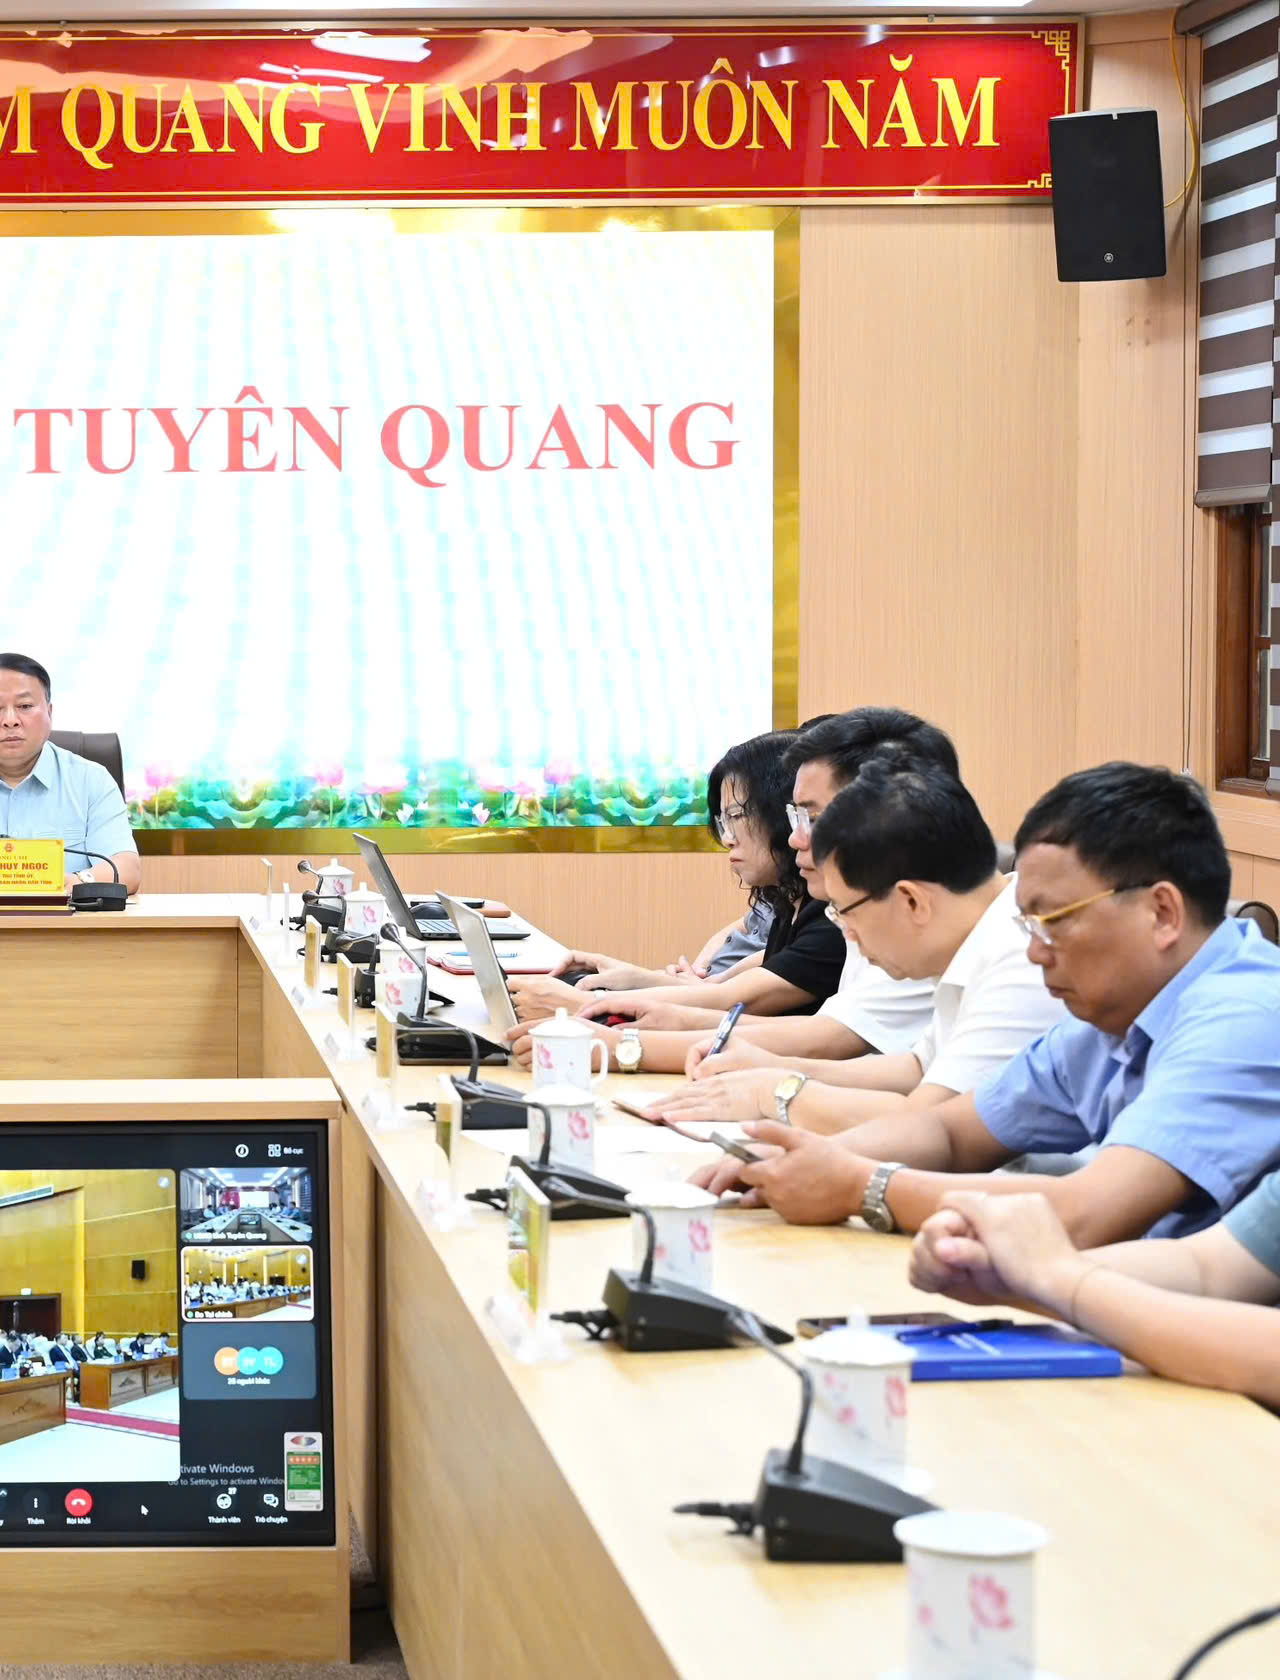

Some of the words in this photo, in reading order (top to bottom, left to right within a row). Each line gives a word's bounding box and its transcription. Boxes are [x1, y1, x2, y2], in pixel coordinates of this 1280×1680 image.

[61, 82, 326, 170] QUANG
[350, 81, 548, 152] VINH
[570, 57, 798, 151] MUÔN
[821, 53, 1001, 149] NĂM
[13, 385, 347, 473] TUYÊN
[380, 402, 741, 488] QUANG
[179, 1463, 207, 1474] tivate
[209, 1463, 255, 1474] Windows
[189, 1477, 219, 1487] Settings
[220, 1478, 229, 1486] to
[229, 1477, 258, 1486] activate
